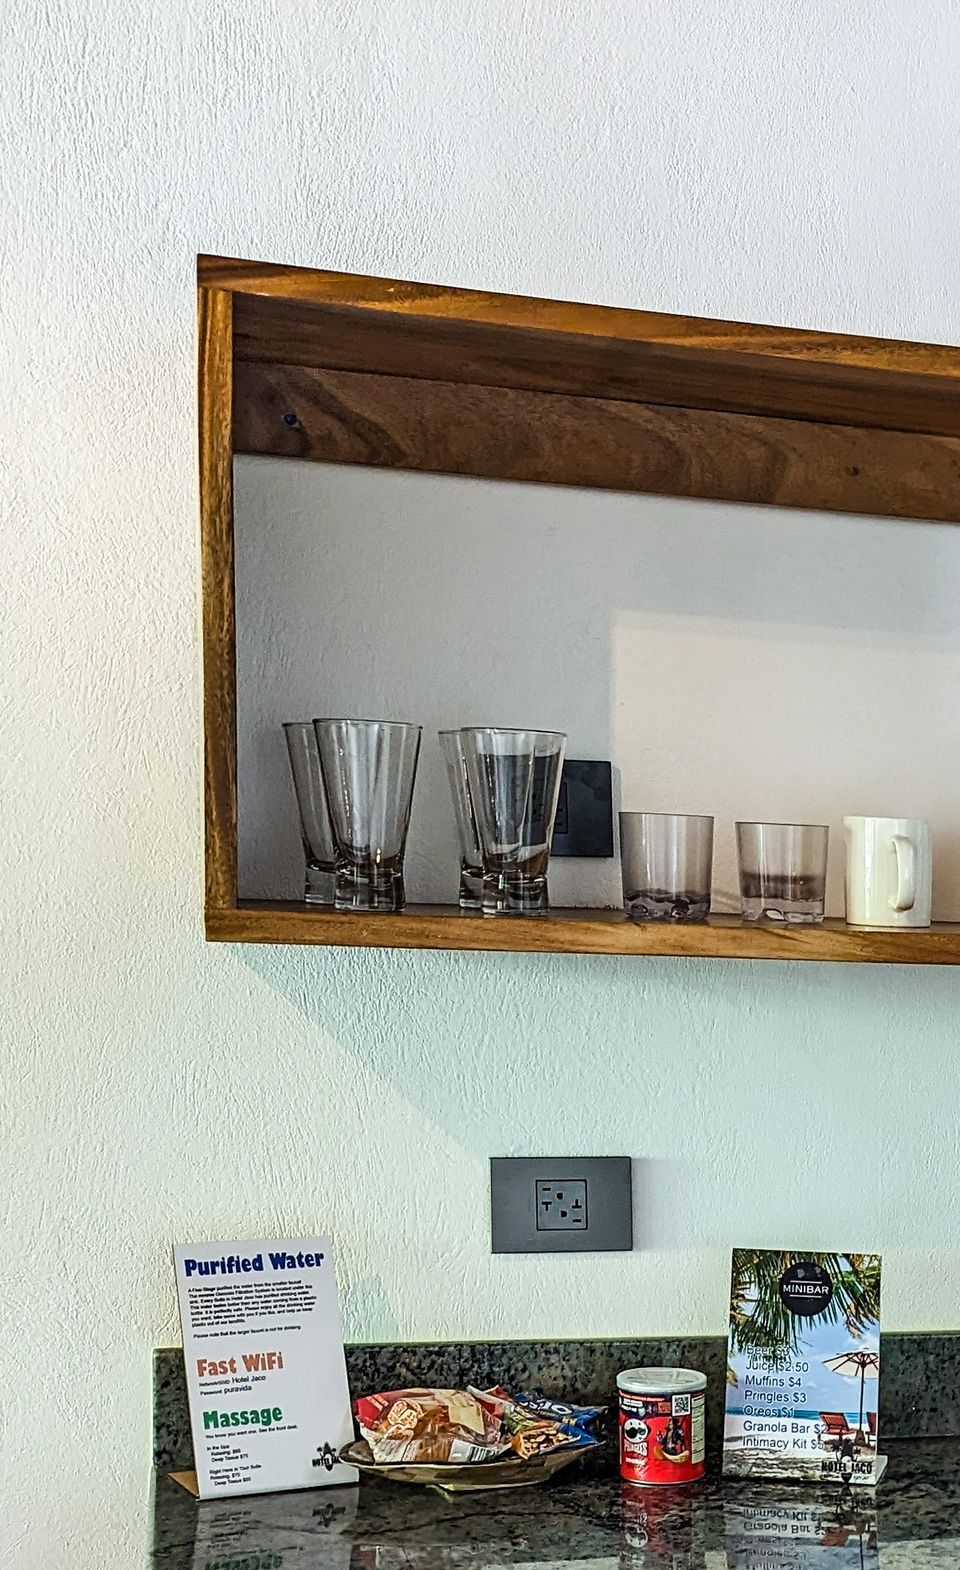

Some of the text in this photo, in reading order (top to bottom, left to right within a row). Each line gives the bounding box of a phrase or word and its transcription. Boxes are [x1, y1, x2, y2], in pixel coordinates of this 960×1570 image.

[184, 1251, 324, 1277] Purified Water
[783, 1284, 829, 1294] MINIBAR
[746, 1345, 790, 1356] Beer $3
[197, 1351, 284, 1377] Fast WiFi
[746, 1360, 809, 1373] Juice $2.50
[231, 1376, 249, 1384] Hotel
[745, 1374, 801, 1387] Muffins $4
[744, 1390, 807, 1404] Pringles $3
[743, 1405, 794, 1417] Oreos $1
[203, 1407, 283, 1430] Massage
[743, 1420, 828, 1434] Granola Bar $2
[743, 1436, 789, 1449] Intimacy
[792, 1438, 807, 1449] Kit
